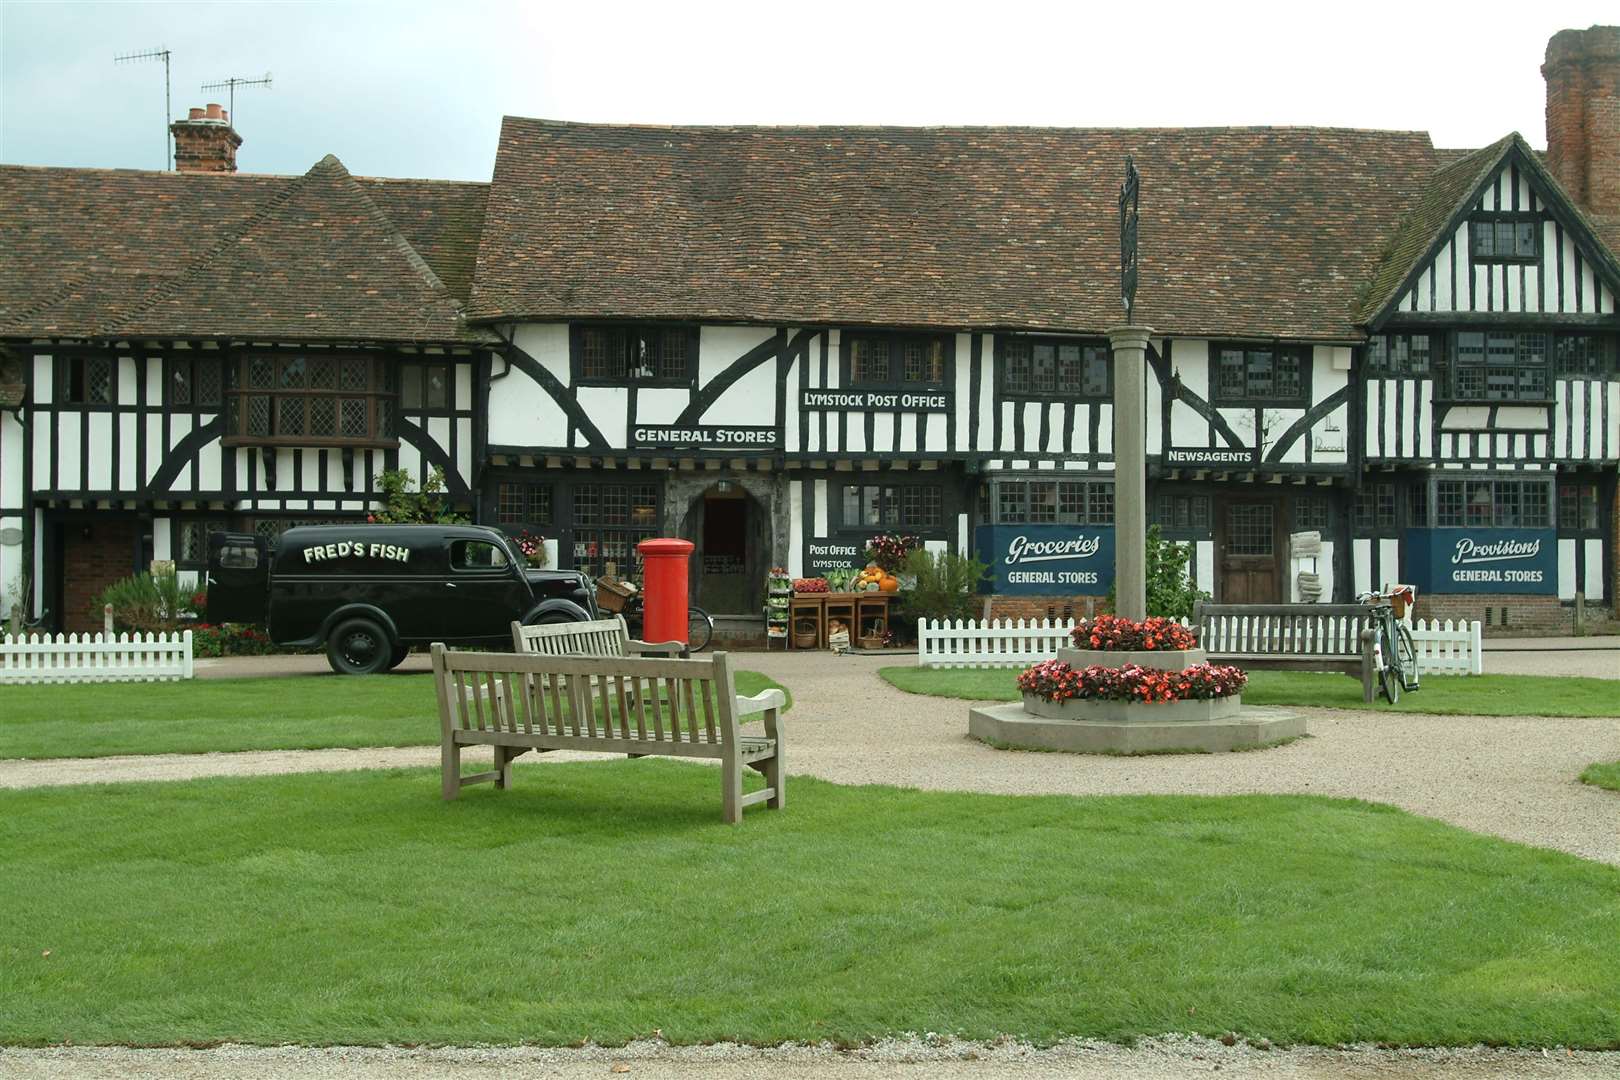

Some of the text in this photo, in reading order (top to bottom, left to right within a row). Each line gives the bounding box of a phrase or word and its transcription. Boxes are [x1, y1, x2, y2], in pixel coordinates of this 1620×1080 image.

[804, 392, 946, 408] LYMSTOCK POST OFFICE
[634, 428, 777, 443] GENERAL STORES
[1168, 450, 1252, 462] NEWSAGENTS
[303, 540, 410, 564] FRED'S FISH
[809, 544, 857, 556] POST OFFICE
[1004, 534, 1100, 565] Groceries
[1451, 538, 1540, 564] Provisions
[812, 560, 852, 569] LYMSTOCK
[1008, 571, 1098, 584] GENERAL STORES
[1452, 569, 1543, 582] GENERAL STORES
